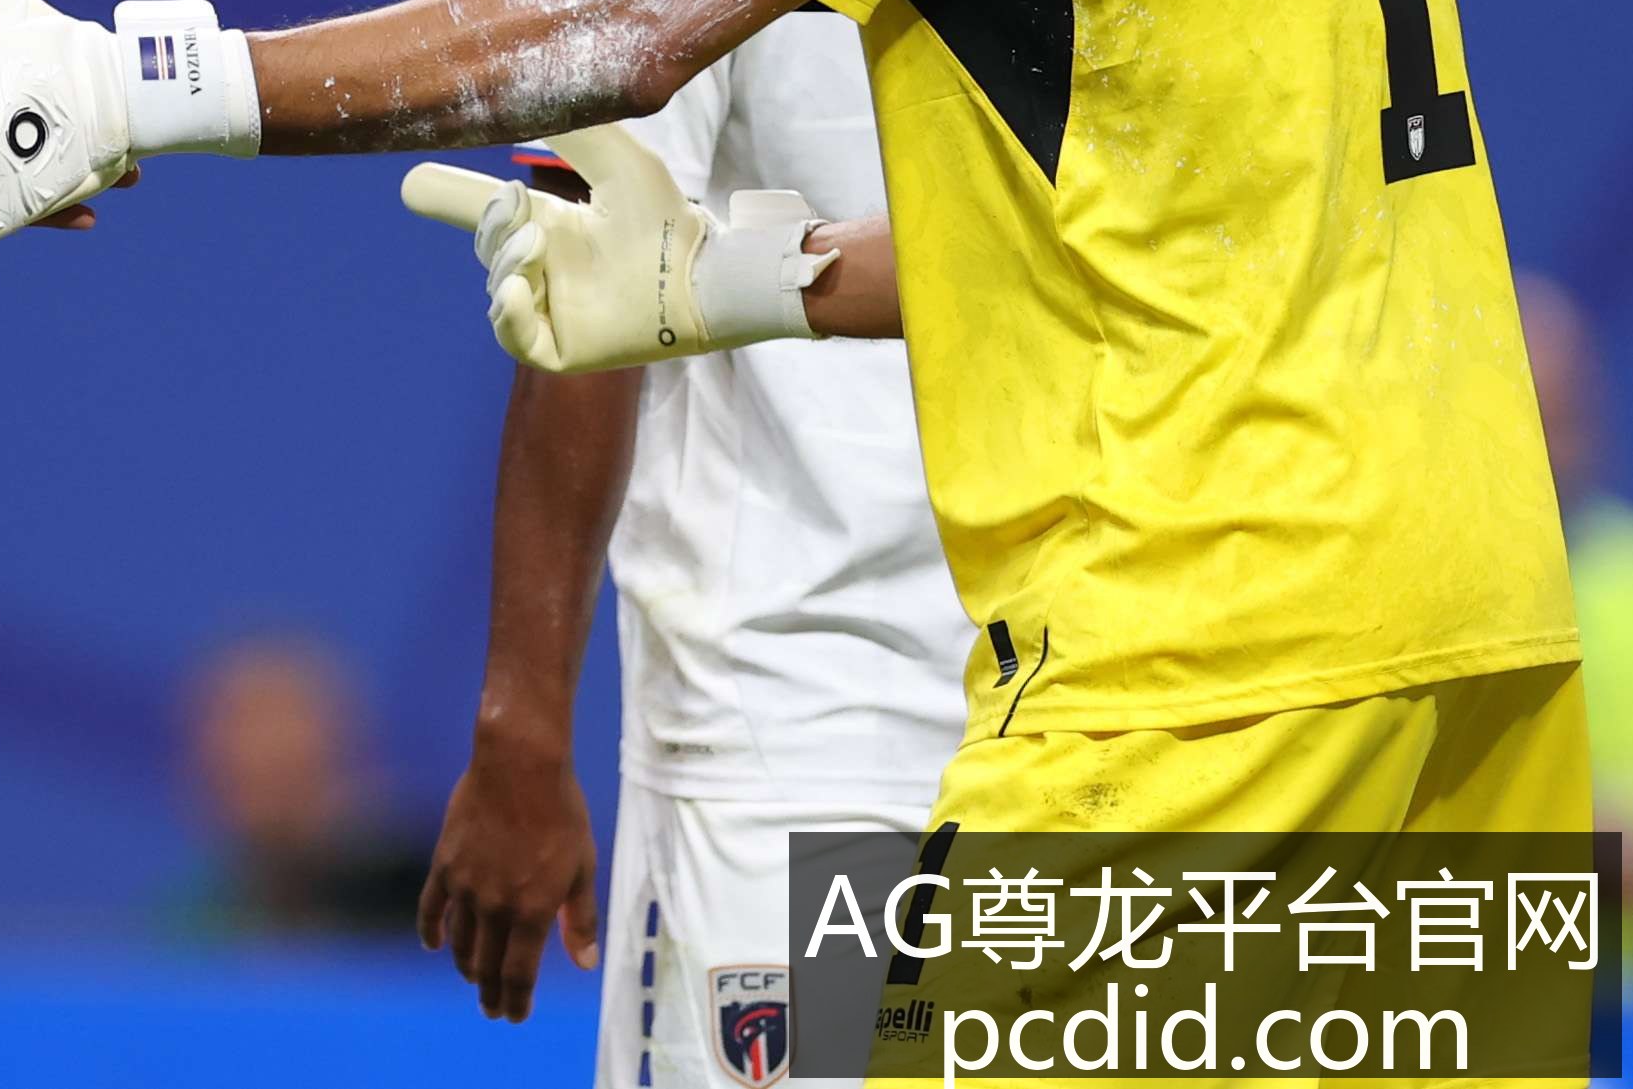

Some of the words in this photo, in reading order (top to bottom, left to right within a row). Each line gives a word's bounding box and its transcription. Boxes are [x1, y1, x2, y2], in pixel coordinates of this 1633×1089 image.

[658, 279, 666, 325] ELITE
[717, 972, 786, 993] FCF
[882, 1030, 930, 1044] SPORT
